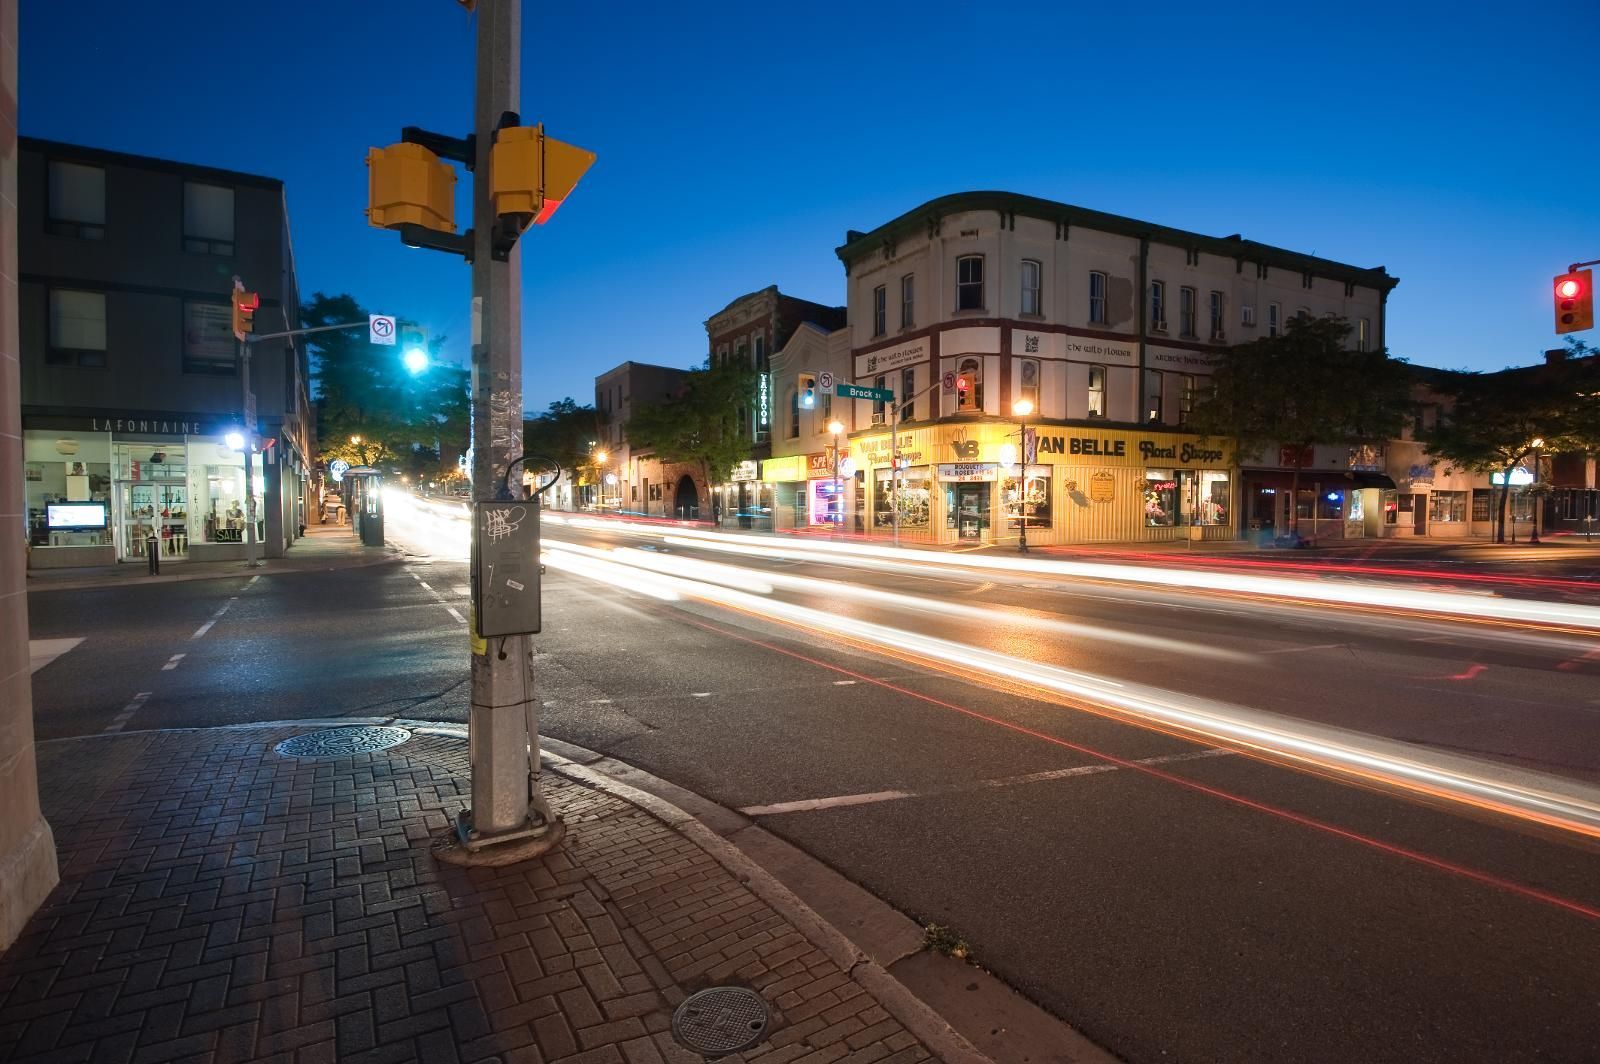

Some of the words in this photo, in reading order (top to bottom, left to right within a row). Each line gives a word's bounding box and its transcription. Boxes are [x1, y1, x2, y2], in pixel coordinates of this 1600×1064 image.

[760, 373, 768, 425] TATTOOS
[850, 388, 872, 398] Brock
[92, 419, 199, 434] LAFONTAINE
[1070, 438, 1125, 457] BELLE
[1139, 441, 1176, 461] Floral
[1180, 443, 1223, 463] Shoppe
[216, 529, 242, 542] SALE
